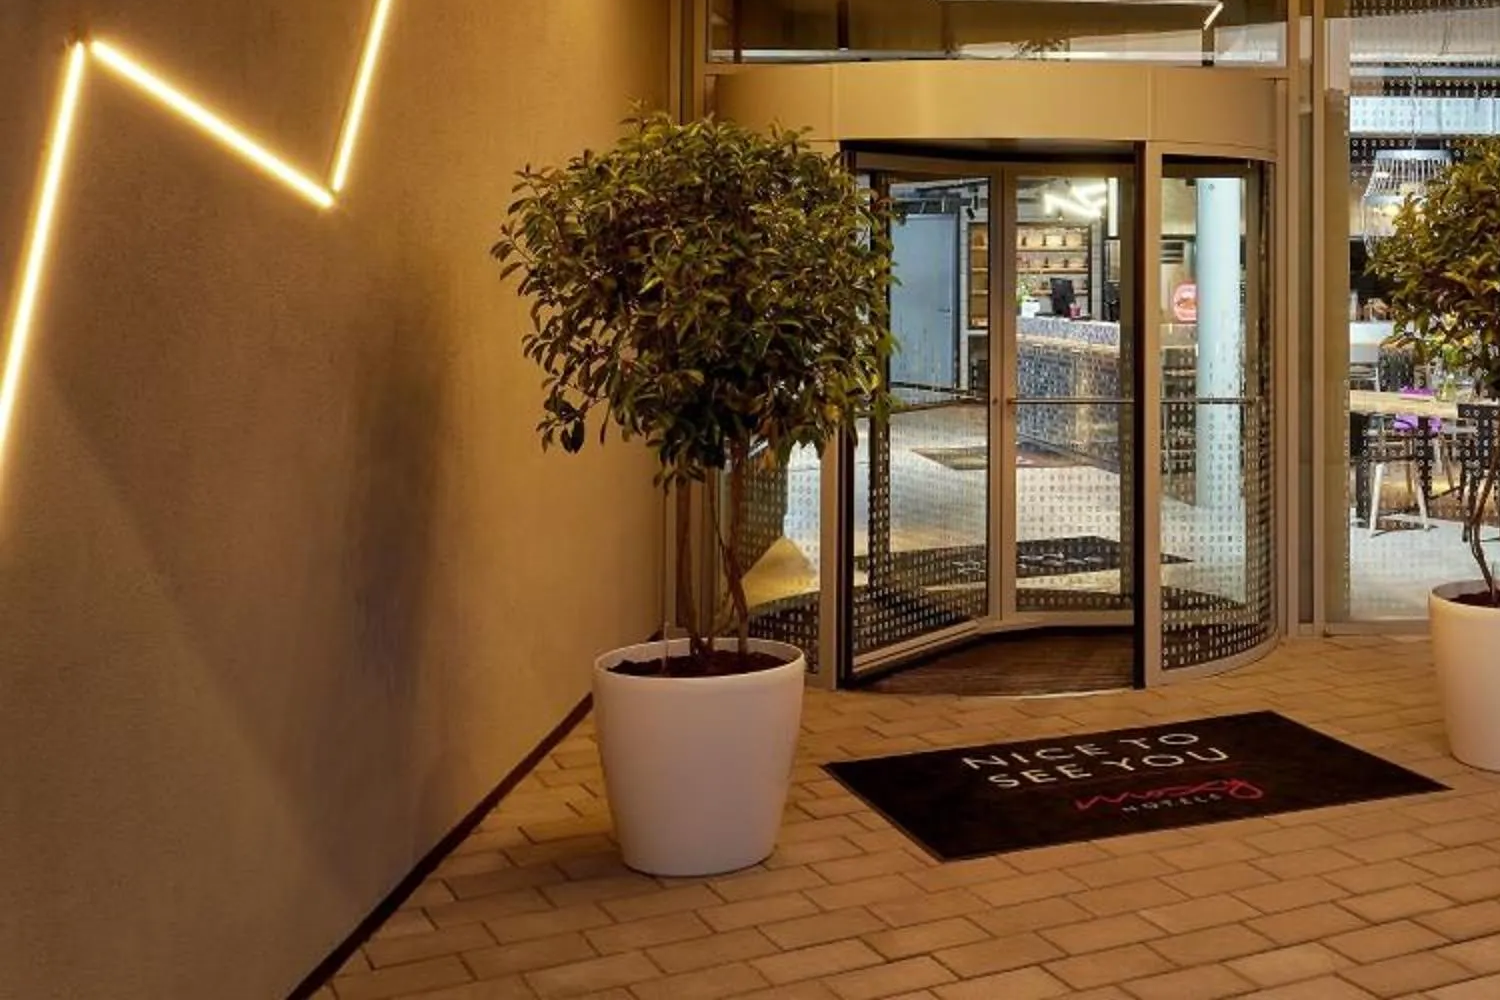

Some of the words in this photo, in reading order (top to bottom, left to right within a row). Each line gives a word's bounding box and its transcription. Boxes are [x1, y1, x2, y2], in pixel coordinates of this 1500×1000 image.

[961, 743, 1110, 770] NICE
[1119, 732, 1199, 750] TO
[988, 763, 1092, 788] SEE
[1102, 746, 1229, 771] YOU
